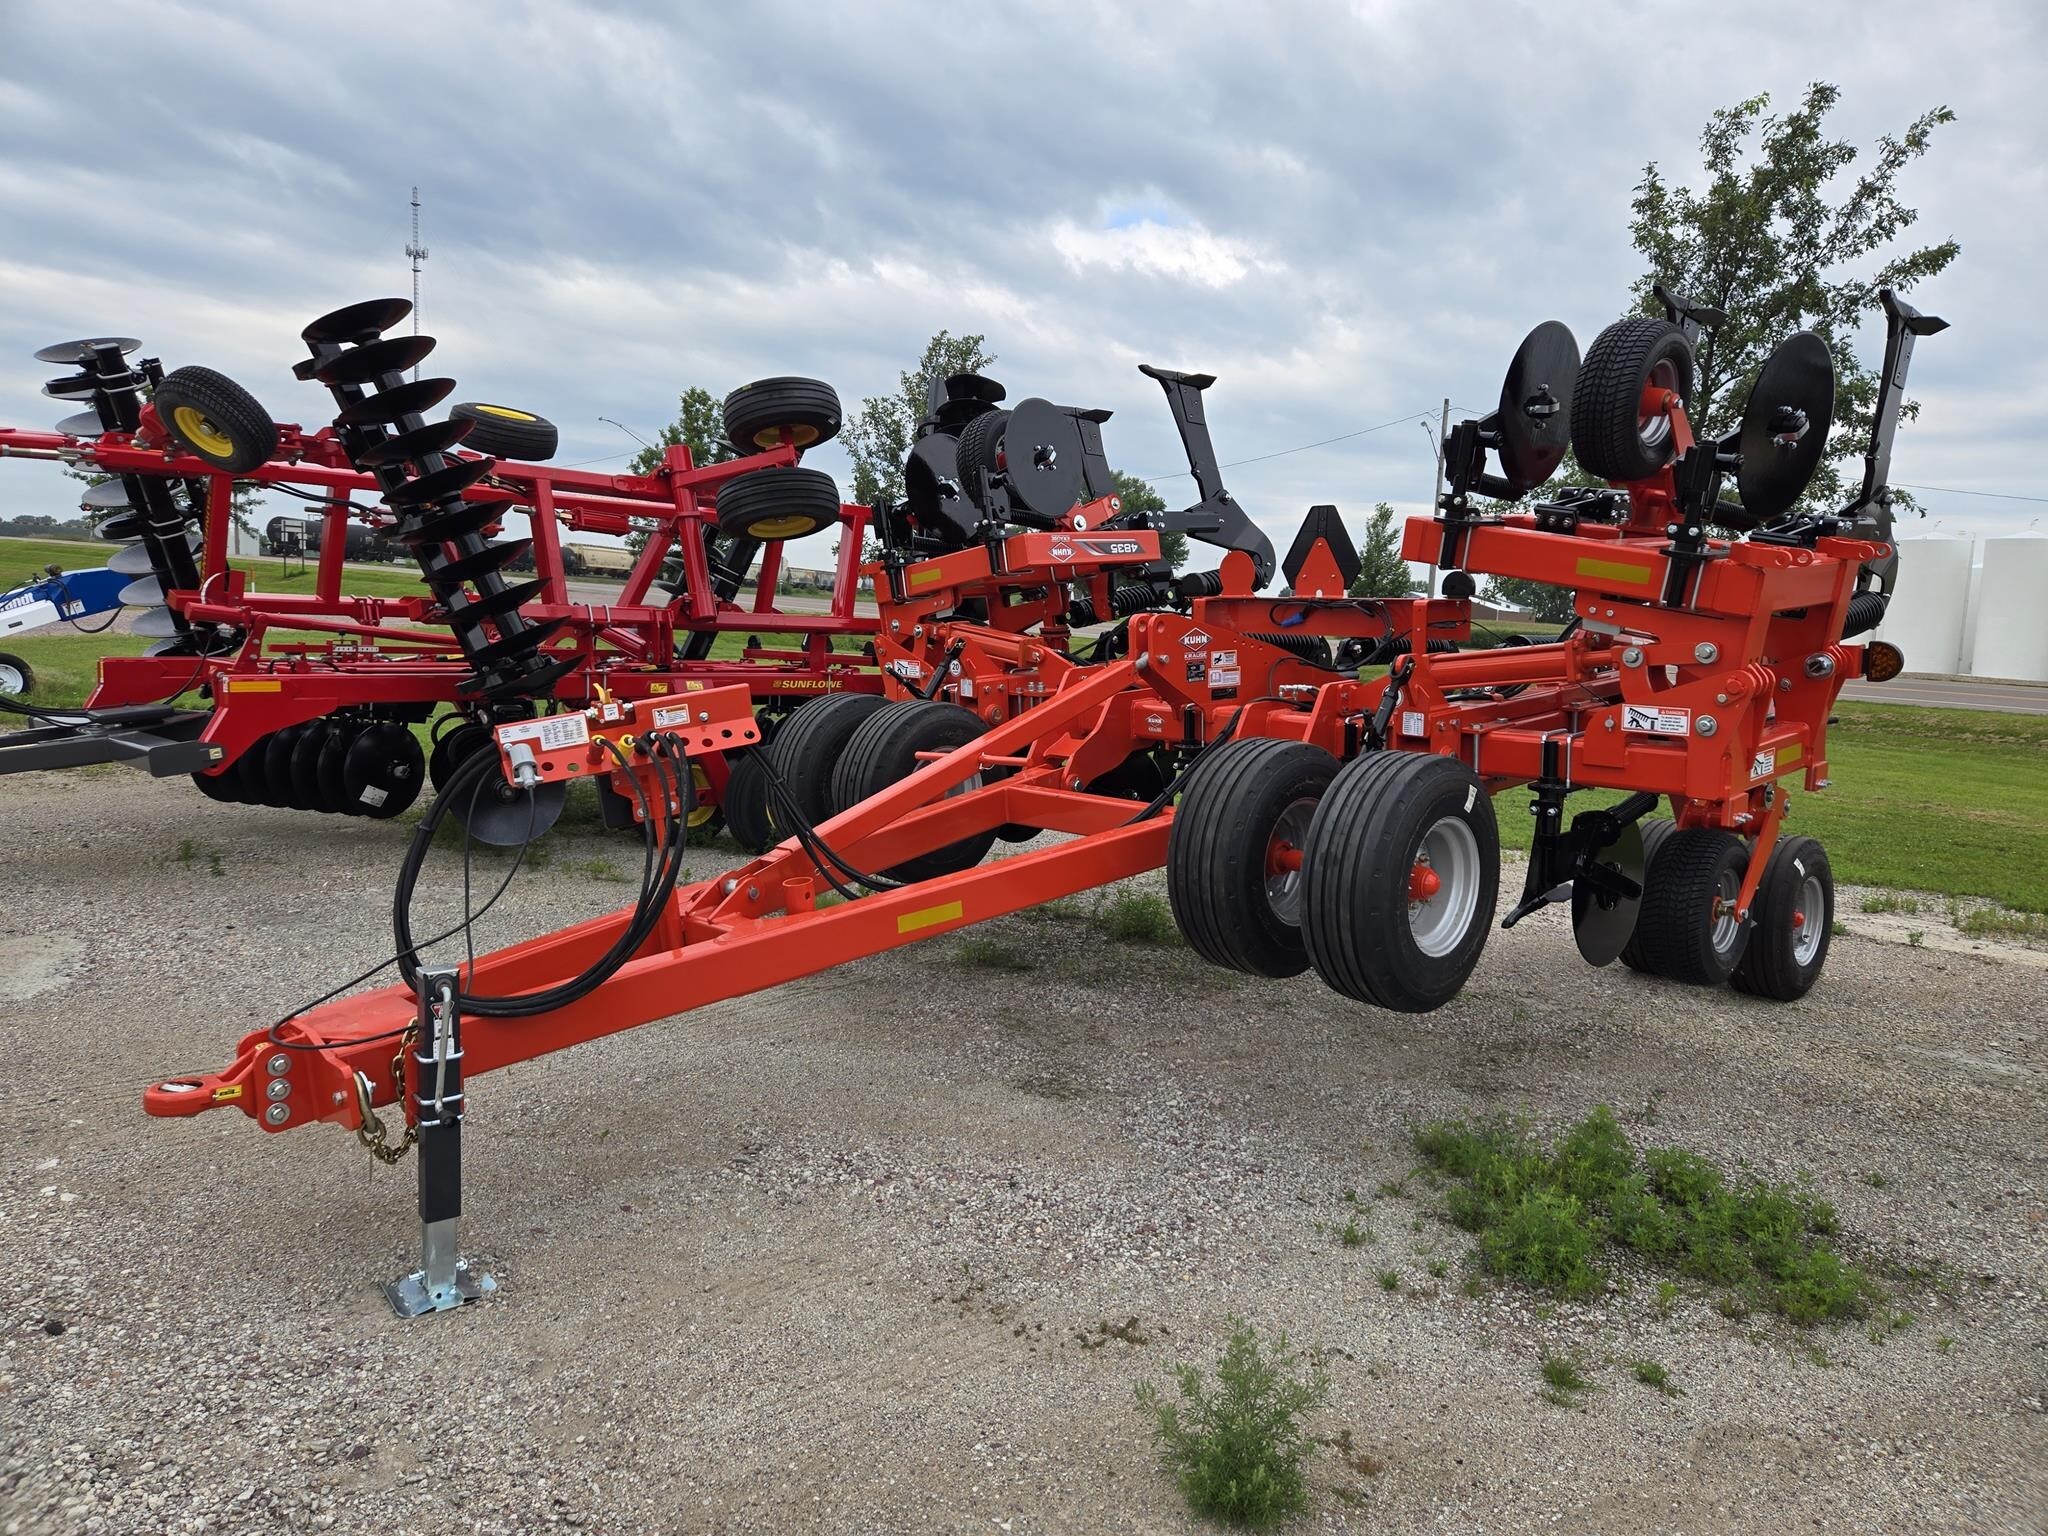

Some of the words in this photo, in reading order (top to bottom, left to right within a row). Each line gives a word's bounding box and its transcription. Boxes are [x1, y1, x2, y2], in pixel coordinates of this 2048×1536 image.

[1052, 548, 1072, 556] KUHN
[1110, 543, 1138, 553] 4835
[1183, 635, 1208, 645] KUHN
[951, 662, 960, 671] 20
